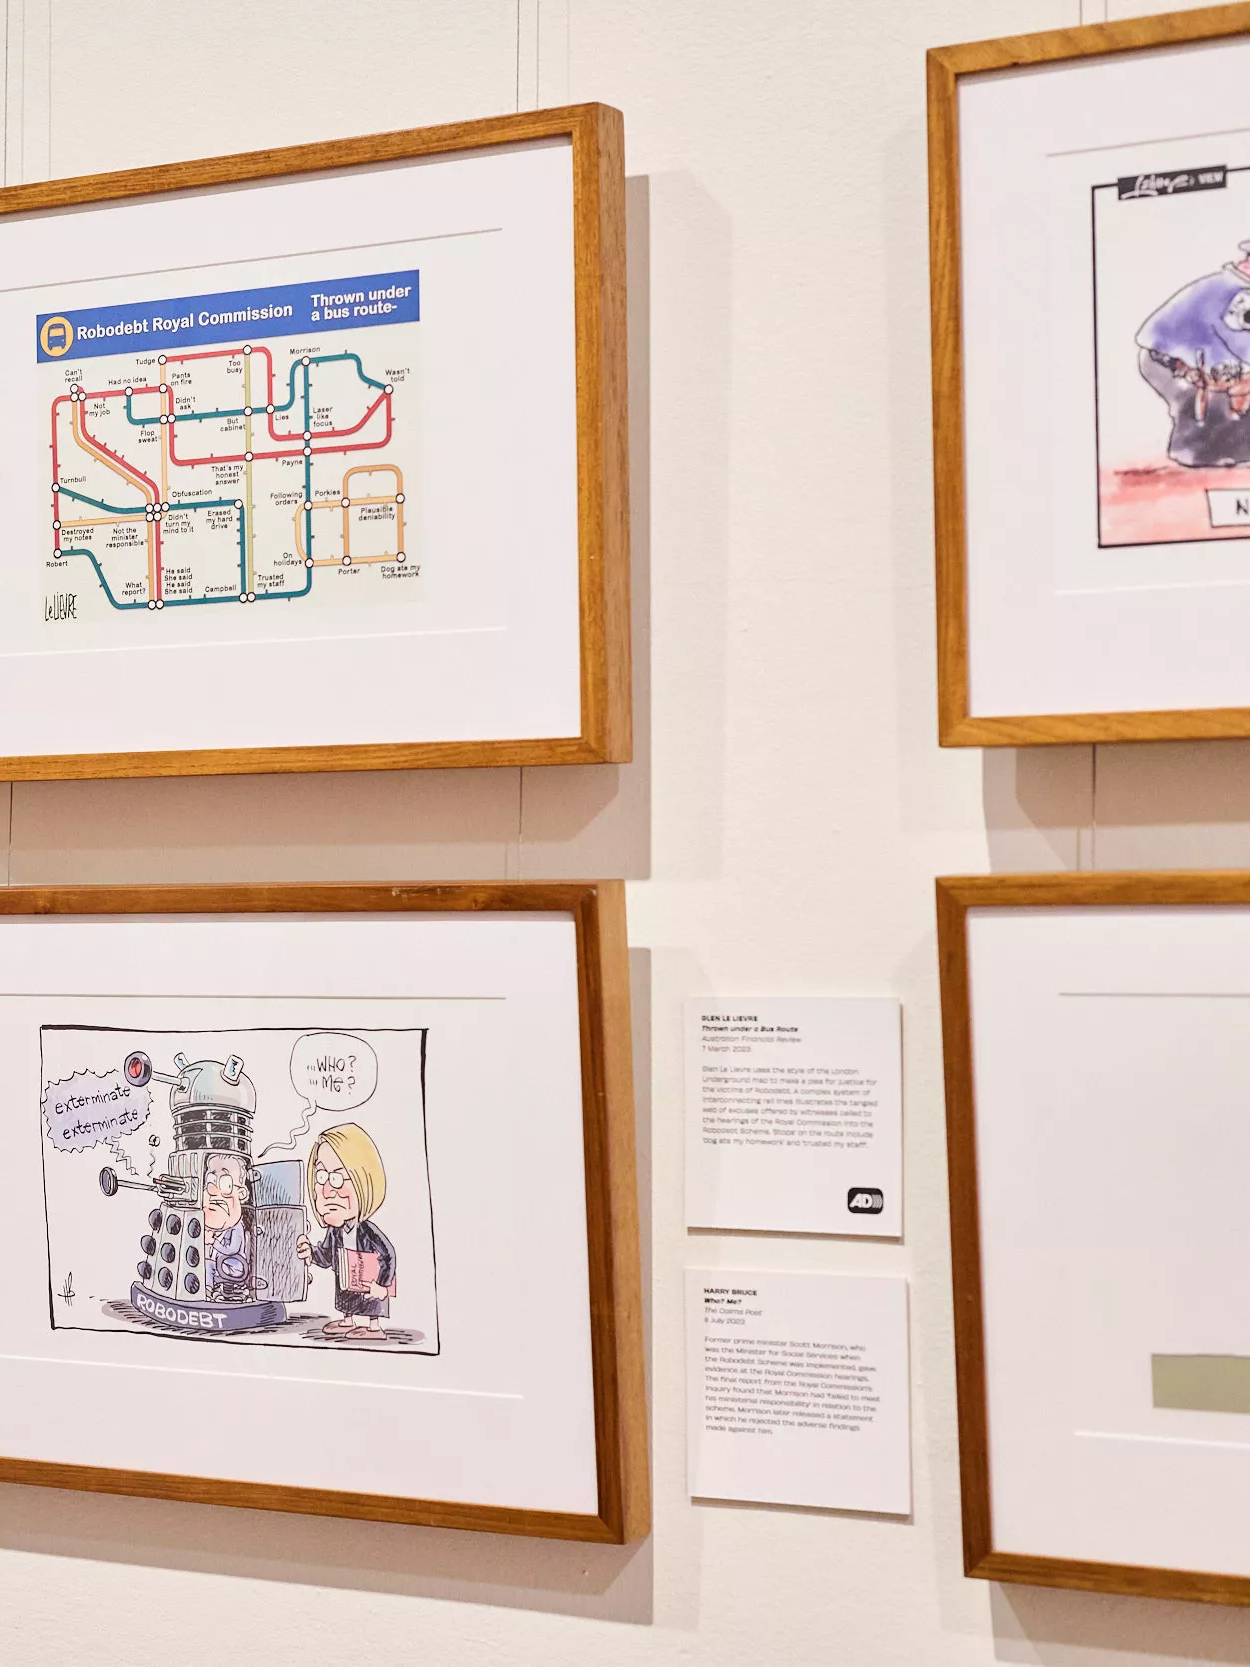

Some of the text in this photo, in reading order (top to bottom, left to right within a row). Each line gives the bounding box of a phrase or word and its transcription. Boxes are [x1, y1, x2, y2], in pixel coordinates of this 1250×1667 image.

[311, 285, 412, 307] Thrown under
[311, 301, 397, 321] a bus route-
[78, 304, 293, 340] Robodebt Royal Commission
[99, 409, 110, 417] job
[172, 489, 212, 497] Obfuscation
[271, 491, 303, 499] Following
[361, 506, 392, 514] Plausible
[359, 513, 395, 521] deniability
[62, 528, 94, 536] Destroyed
[106, 540, 144, 549] responsible
[382, 571, 420, 579] homework
[122, 588, 146, 596] report?
[205, 585, 236, 593] Campbell
[55, 1083, 131, 1114] exterminate
[62, 1107, 138, 1139] exterminate
[137, 1293, 228, 1328] ROBODEBT
